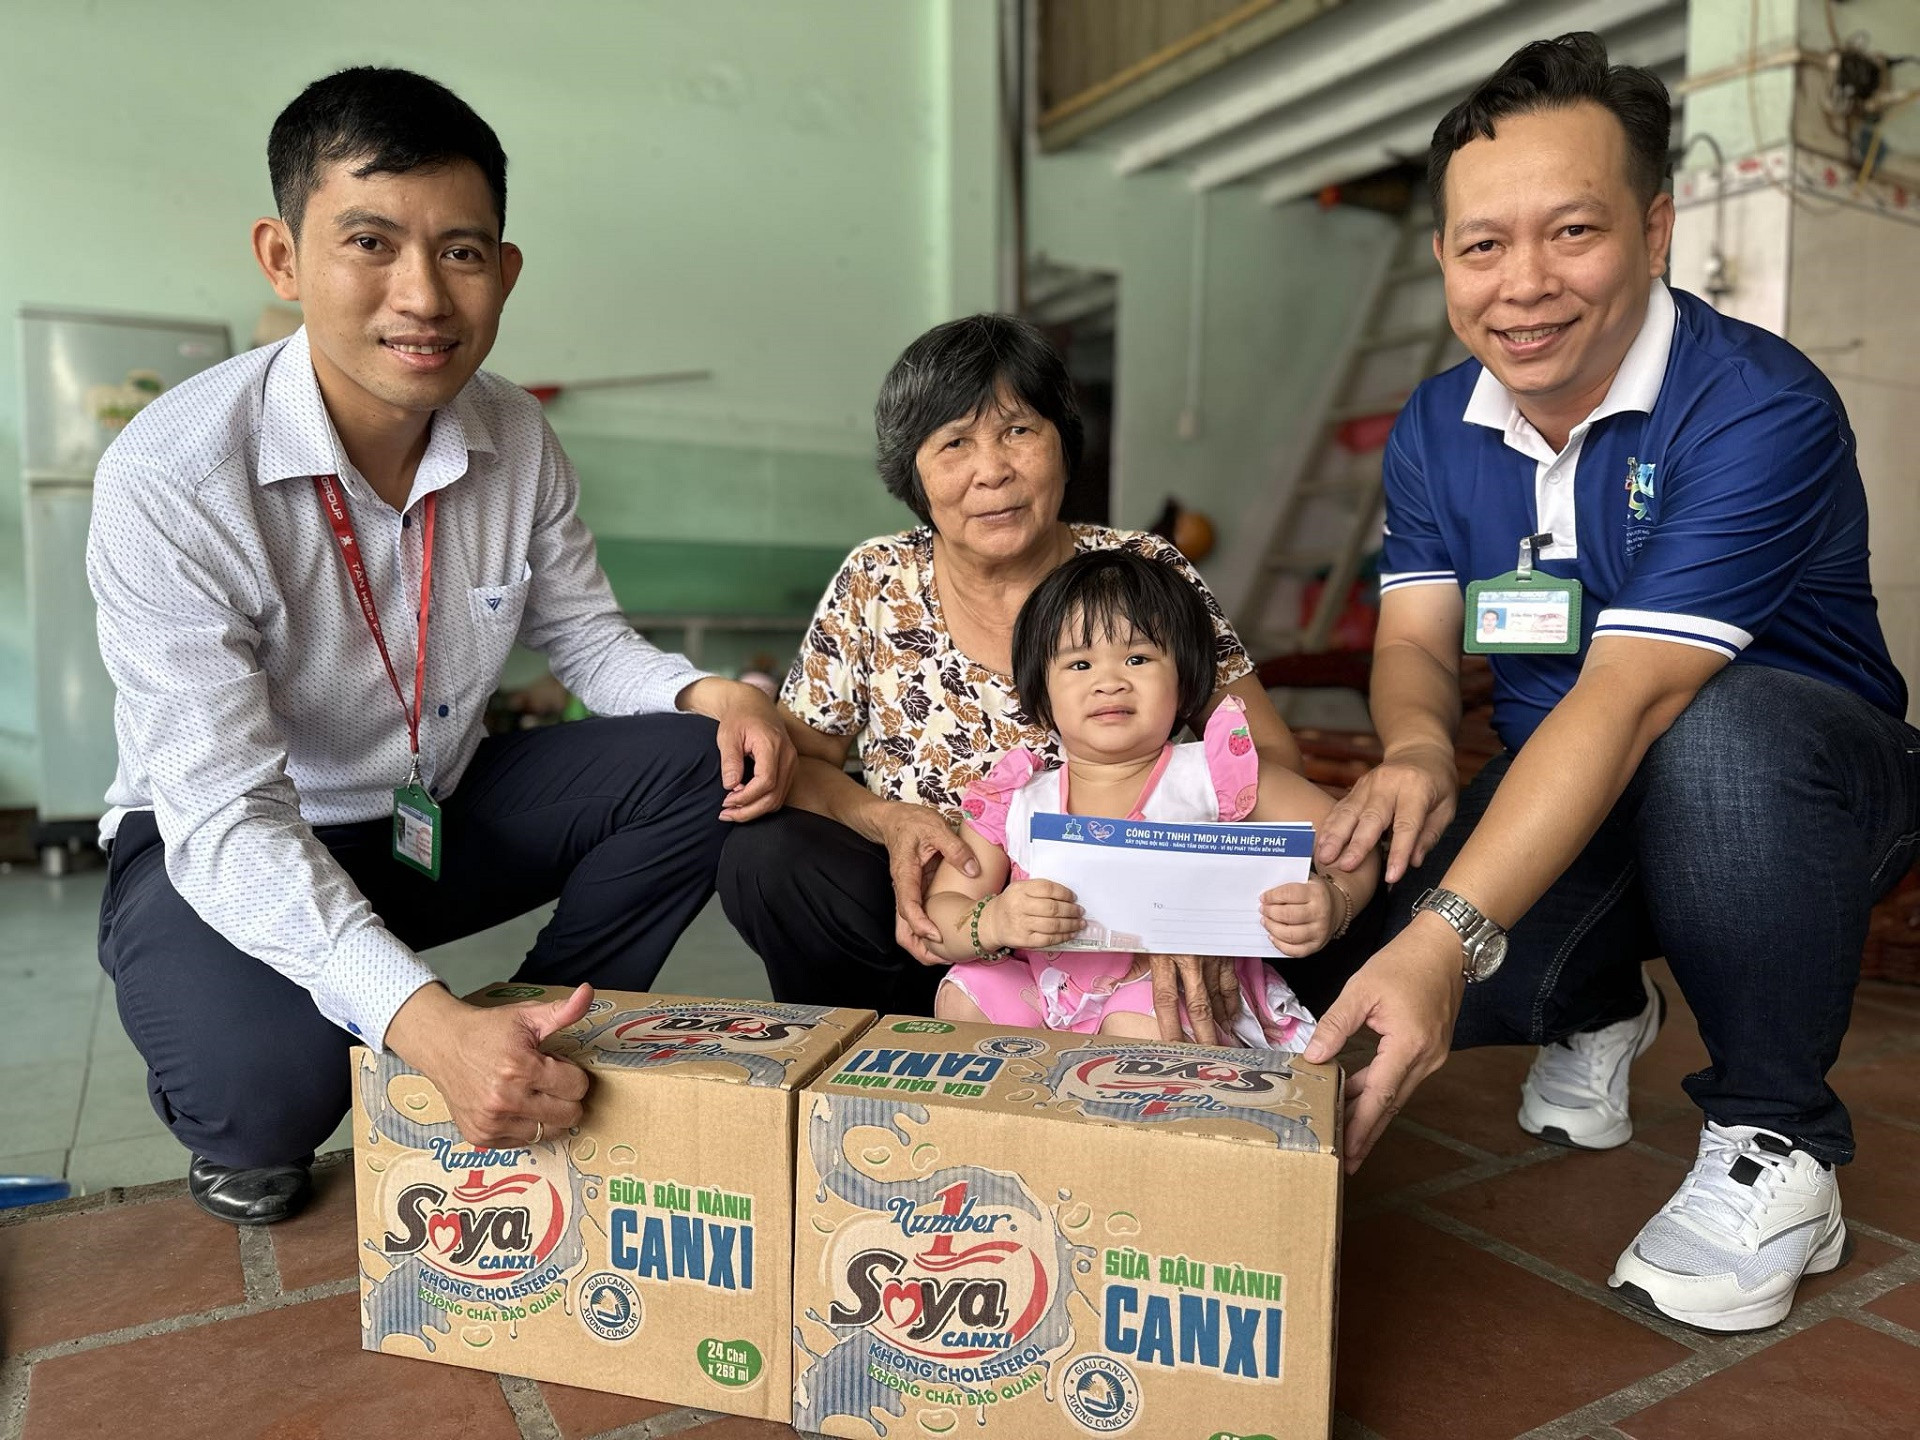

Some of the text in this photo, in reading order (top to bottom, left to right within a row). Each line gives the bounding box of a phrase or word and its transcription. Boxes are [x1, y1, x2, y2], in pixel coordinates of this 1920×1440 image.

[320, 477, 343, 521] GROUP
[1126, 827, 1287, 847] CÔNG TY TNHH TMDV TÂN HIỆP PHÁT
[842, 1050, 1005, 1082] CANXI
[429, 1138, 531, 1172] Number
[654, 1182, 691, 1214] ĐẬU
[697, 1188, 752, 1221] NÀNH
[887, 1196, 1012, 1238] Number
[921, 1180, 969, 1256] 1
[478, 1254, 536, 1270] CANXI
[611, 1208, 753, 1290] CANXI
[418, 1264, 565, 1301] KHÔNG CHOLESTEROL
[608, 1277, 633, 1296] CANXI
[1105, 1247, 1282, 1302] SỮA ĐẬU NÀNH
[418, 1288, 562, 1322] KHÔNG CHẤT BẢO QUẢN
[941, 1331, 1013, 1348] CANXI
[1105, 1284, 1283, 1379] CANXI
[708, 1340, 747, 1364] 24 Chai
[868, 1342, 1047, 1382] KHÔNG CHOLESTEROL
[716, 1363, 735, 1379] 268
[738, 1367, 749, 1381] ml
[867, 1364, 1043, 1406] KHÔNG CHẤT BẢO QUẢN
[1074, 1360, 1129, 1382] GIÀU CANXI
[1067, 1394, 1135, 1428] XƯƠNG CỨNG CẤP
